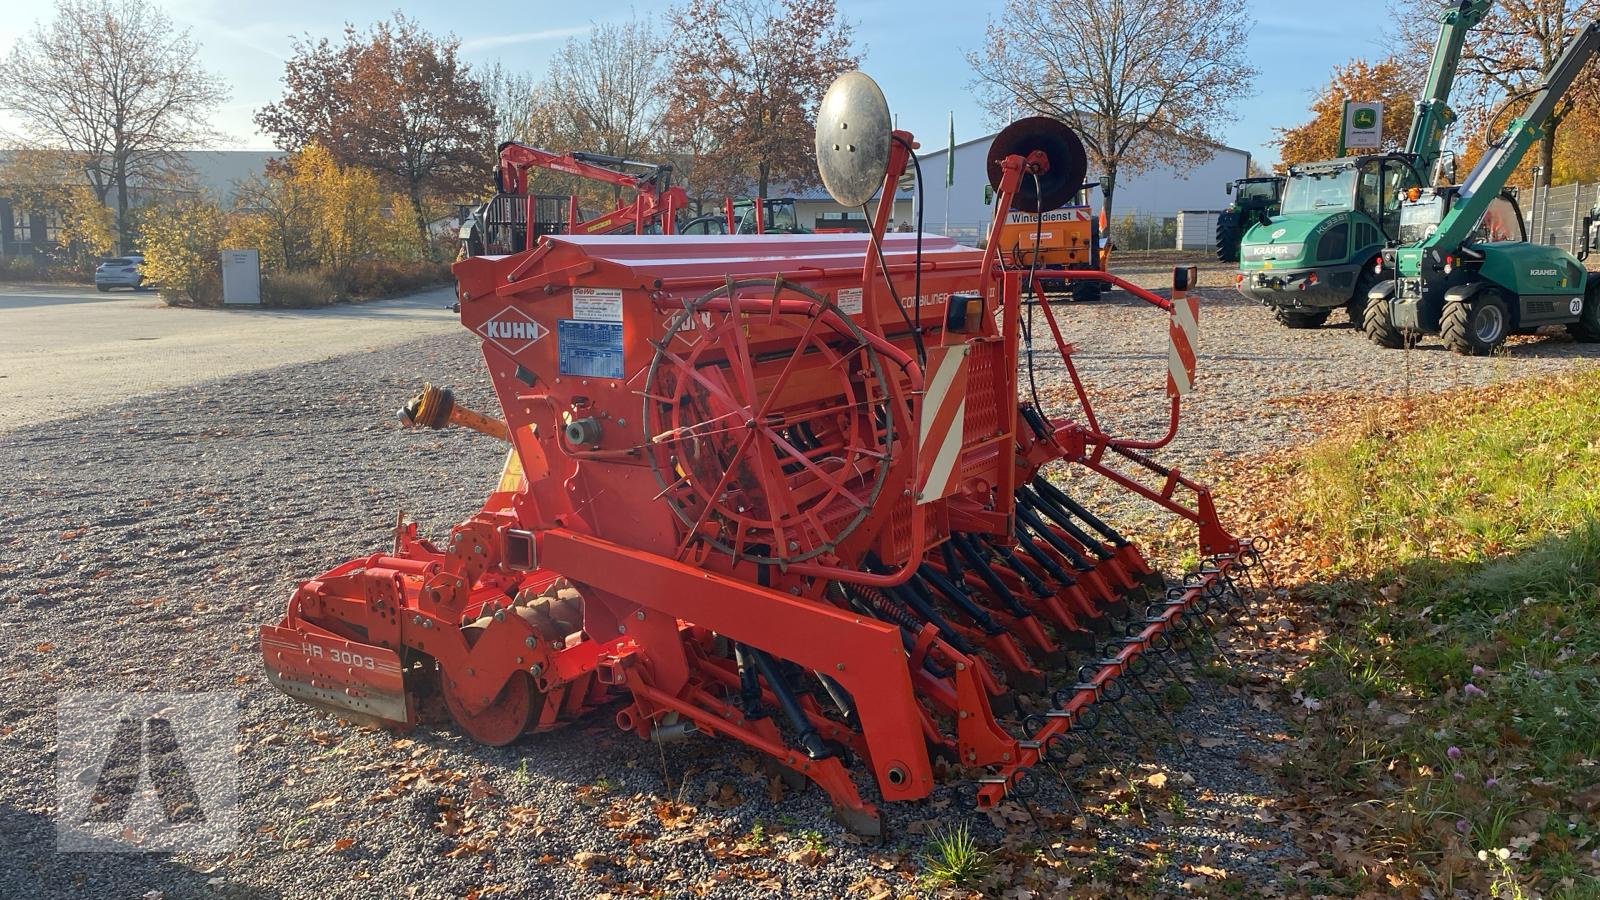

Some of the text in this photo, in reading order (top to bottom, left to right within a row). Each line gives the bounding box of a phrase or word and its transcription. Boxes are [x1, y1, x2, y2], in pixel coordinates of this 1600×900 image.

[1012, 211, 1071, 223] Wintedienst
[1253, 246, 1288, 255] KRAMER
[1572, 300, 1580, 312] 20
[487, 321, 539, 339] KUHN
[302, 642, 375, 670] HR 3003
